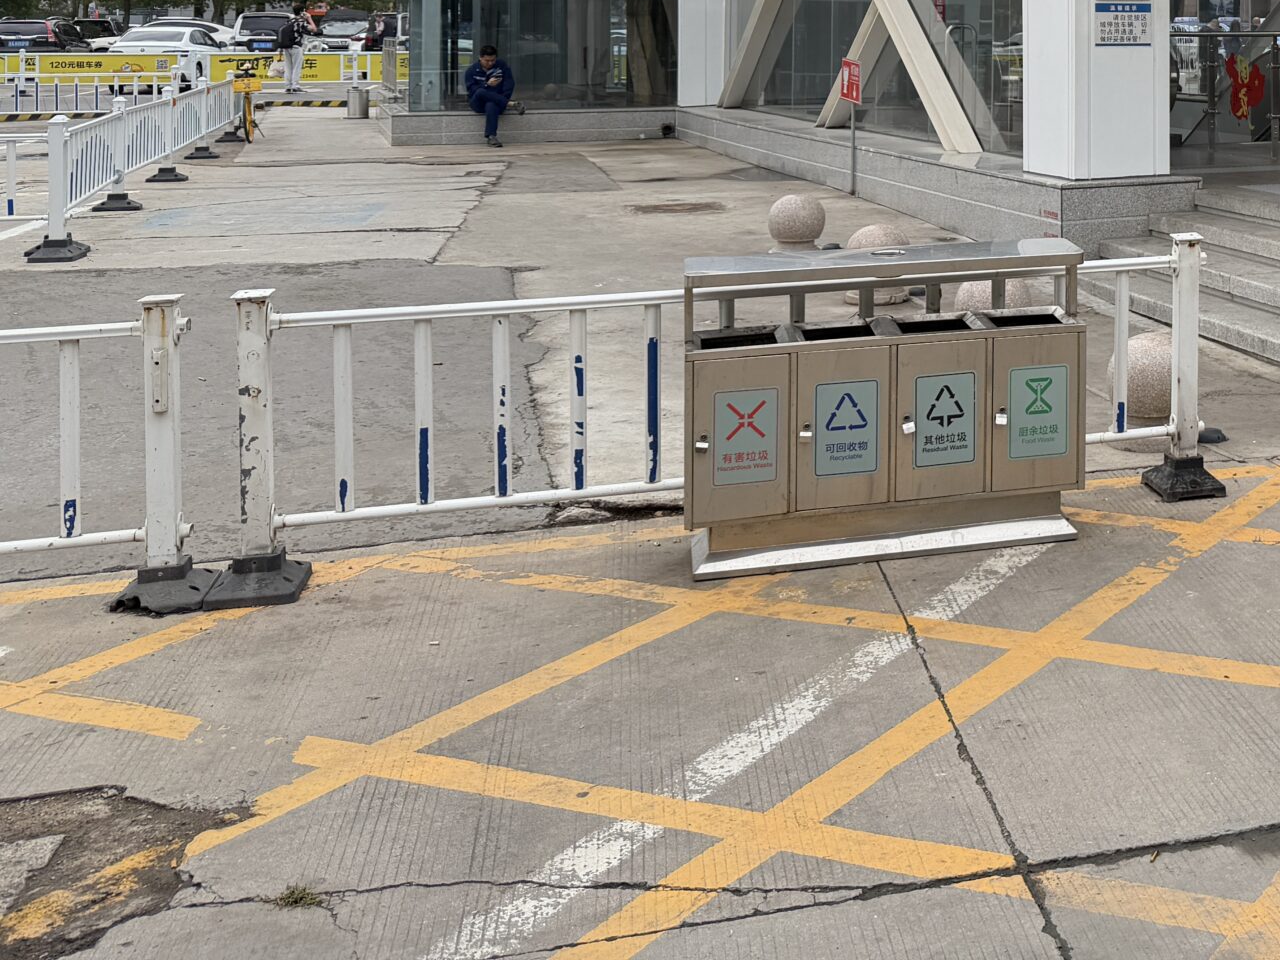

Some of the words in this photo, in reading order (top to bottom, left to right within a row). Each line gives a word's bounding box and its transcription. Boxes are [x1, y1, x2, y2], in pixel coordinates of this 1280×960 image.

[49, 60, 103, 69] 120元租车券
[1018, 424, 1059, 437] 厨余垃圾
[923, 432, 967, 445] 其他垃圾
[825, 441, 868, 453] 可回收物
[922, 445, 948, 453] Residual
[722, 450, 769, 464] 有害垃圾
[829, 453, 863, 462] Recyclable
[717, 464, 751, 472] Hazardous
[752, 462, 773, 470] Waste
